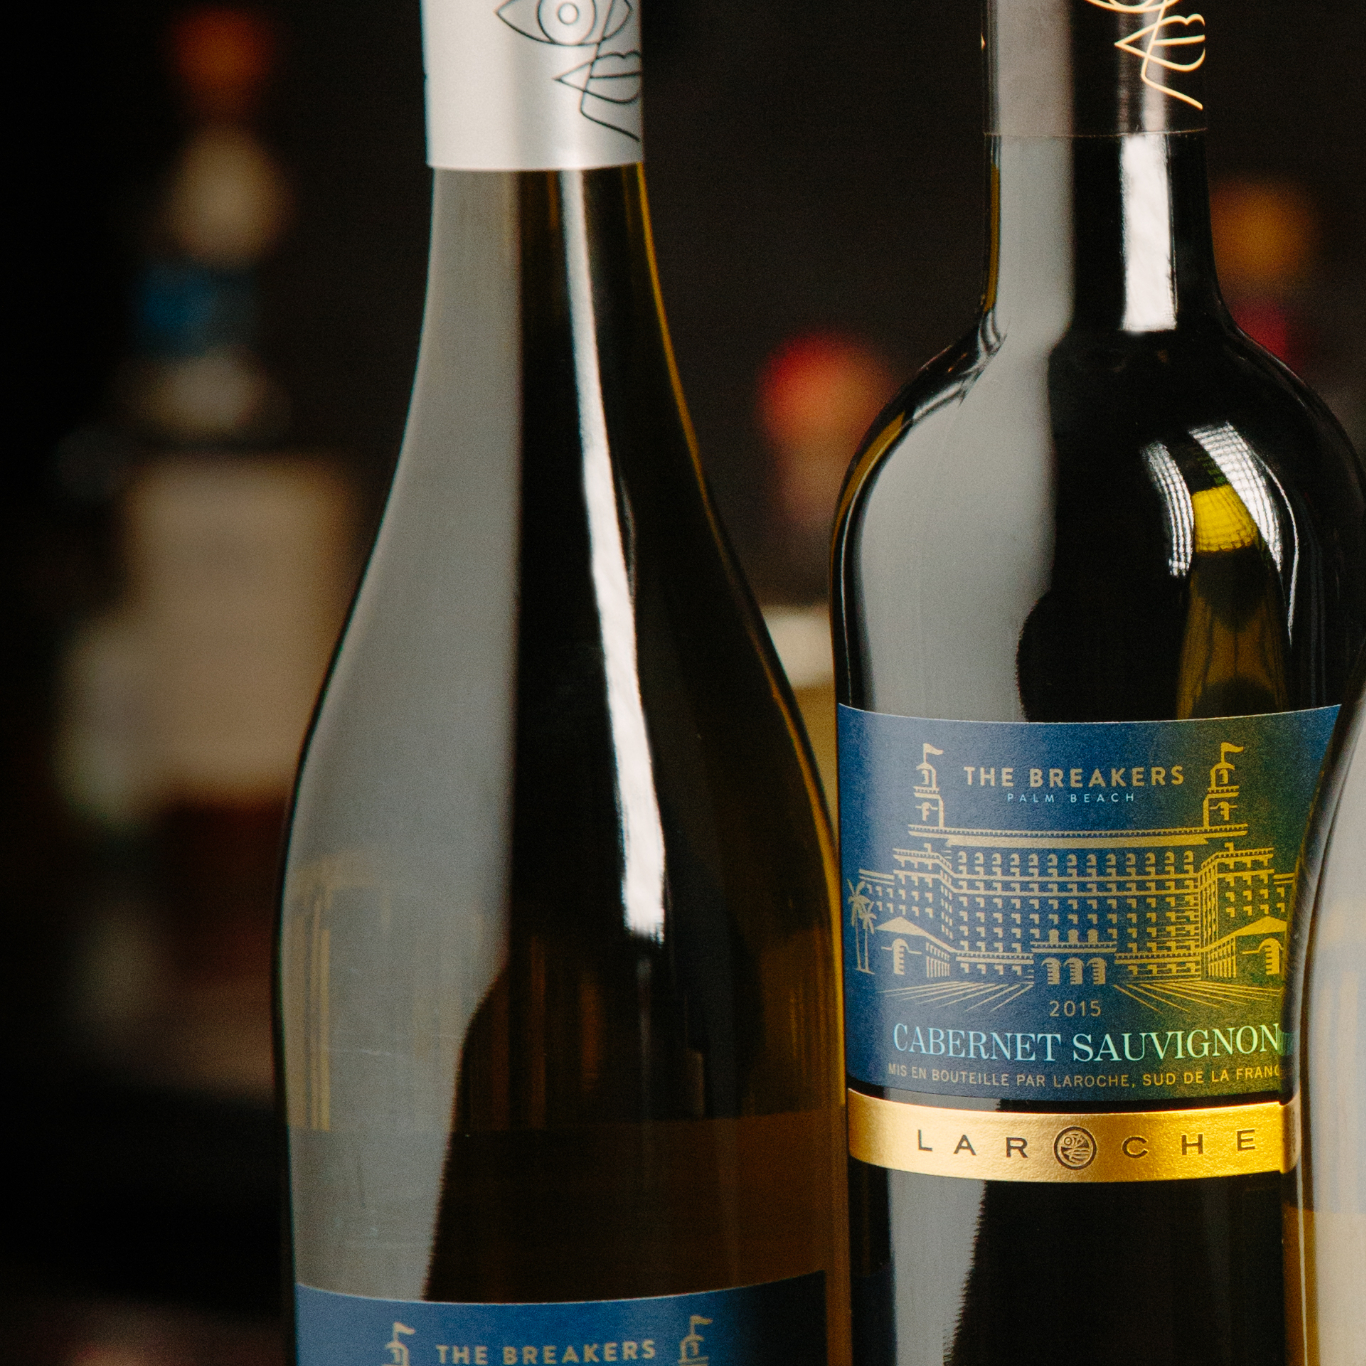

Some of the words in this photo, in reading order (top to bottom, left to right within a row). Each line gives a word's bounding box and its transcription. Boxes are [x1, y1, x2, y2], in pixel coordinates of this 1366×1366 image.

[964, 766, 1014, 787] THE
[1029, 765, 1185, 788] BREAKERS
[1007, 792, 1056, 804] PALM
[1070, 791, 1135, 803] BEACH
[1049, 999, 1101, 1018] 2015
[892, 1022, 1061, 1063] CABERNET
[1072, 1022, 1280, 1063] SAUVIGNON
[887, 1063, 908, 1078] MIS
[911, 1068, 928, 1081] EN
[932, 1070, 1009, 1088] BOUTEILLE
[1016, 1075, 1046, 1088] PAR
[1053, 1074, 1135, 1089] LAROCHE,
[1143, 1072, 1177, 1087] SUD
[1183, 1071, 1205, 1085] DE
[1211, 1068, 1231, 1083] LA
[1236, 1064, 1280, 1081] FRANC
[435, 1343, 489, 1366] THE
[502, 1338, 657, 1366] BREAKERS
